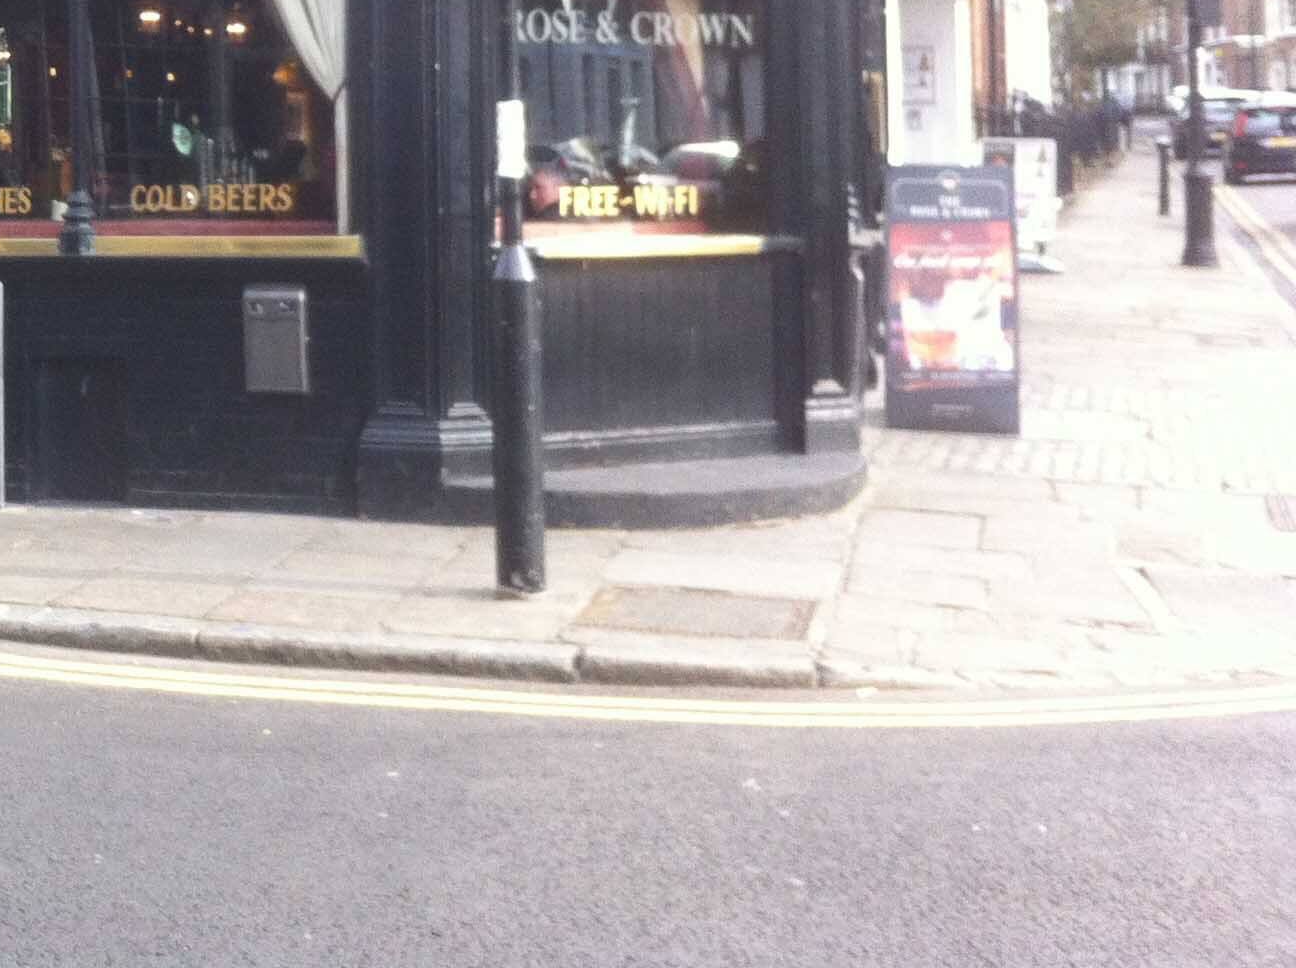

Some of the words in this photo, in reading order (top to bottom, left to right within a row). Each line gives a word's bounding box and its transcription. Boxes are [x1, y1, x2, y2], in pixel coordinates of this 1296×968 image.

[596, 10, 622, 44] &
[629, 11, 754, 48] CROWN
[130, 184, 200, 213] COLD
[207, 183, 294, 213] BEERS
